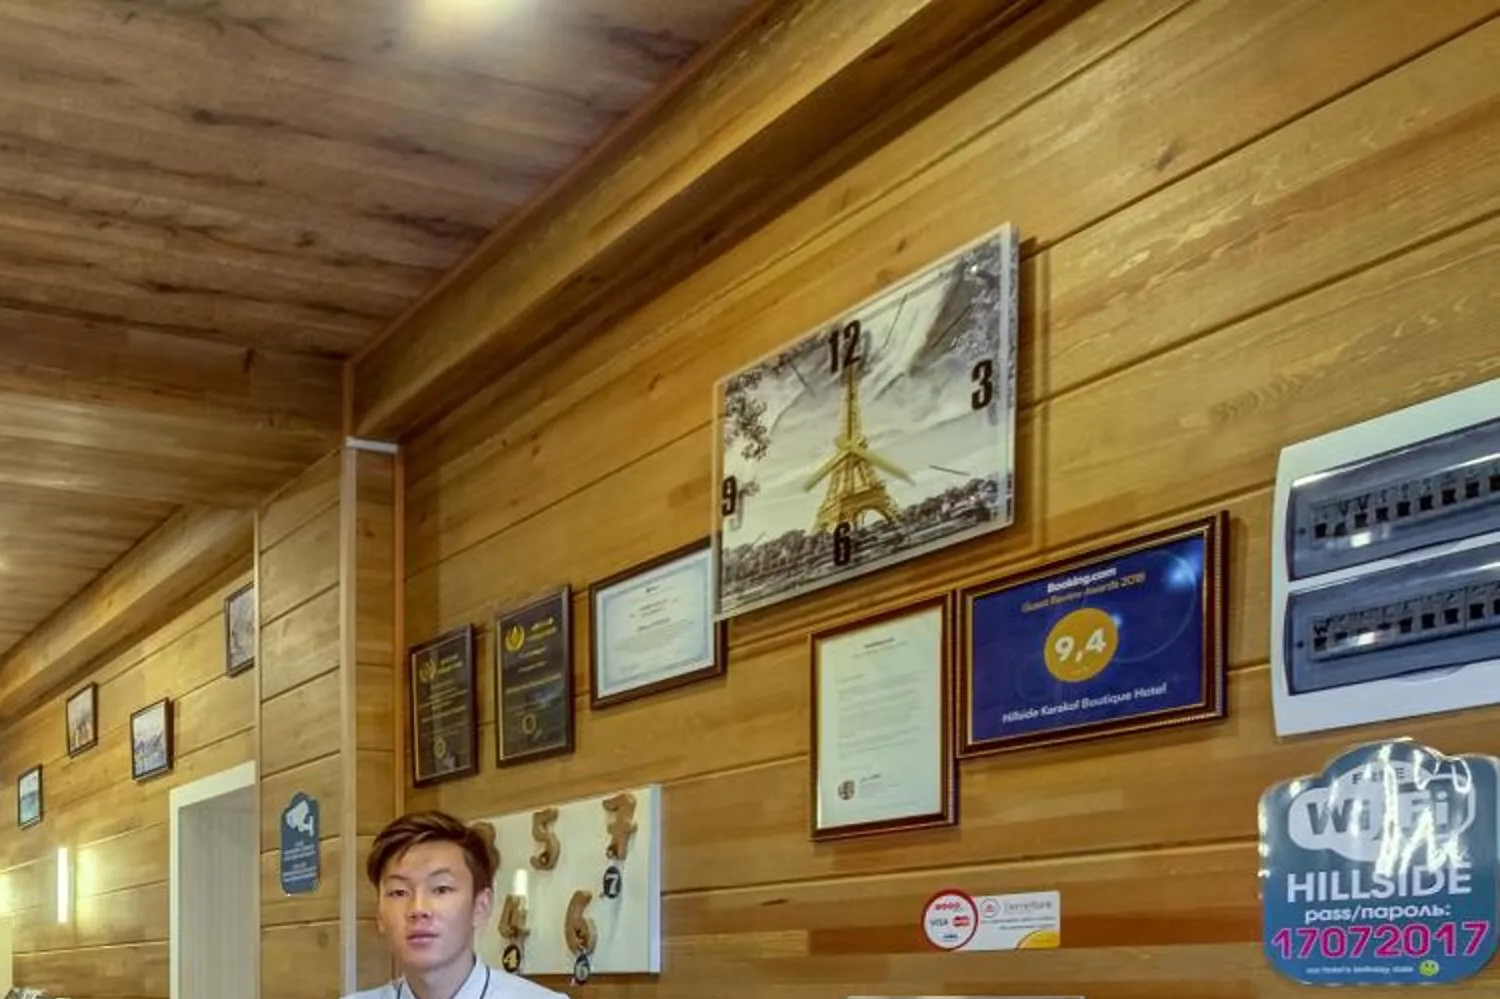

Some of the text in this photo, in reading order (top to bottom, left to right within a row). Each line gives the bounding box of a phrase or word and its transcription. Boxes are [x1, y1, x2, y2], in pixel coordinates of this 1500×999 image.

[827, 319, 861, 373] 12
[971, 359, 994, 411] 3
[721, 475, 737, 516] 9
[832, 522, 852, 567] 6
[1047, 567, 1117, 593] Booking.com
[1054, 627, 1108, 663] 9,4
[1002, 682, 1168, 724] Hillside Karakol Boutique Hotel
[1351, 767, 1405, 785] FRE
[1286, 861, 1473, 903] HILLSIDE
[1304, 904, 1451, 924] pass/пароль:
[1271, 920, 1491, 960] 17072017
